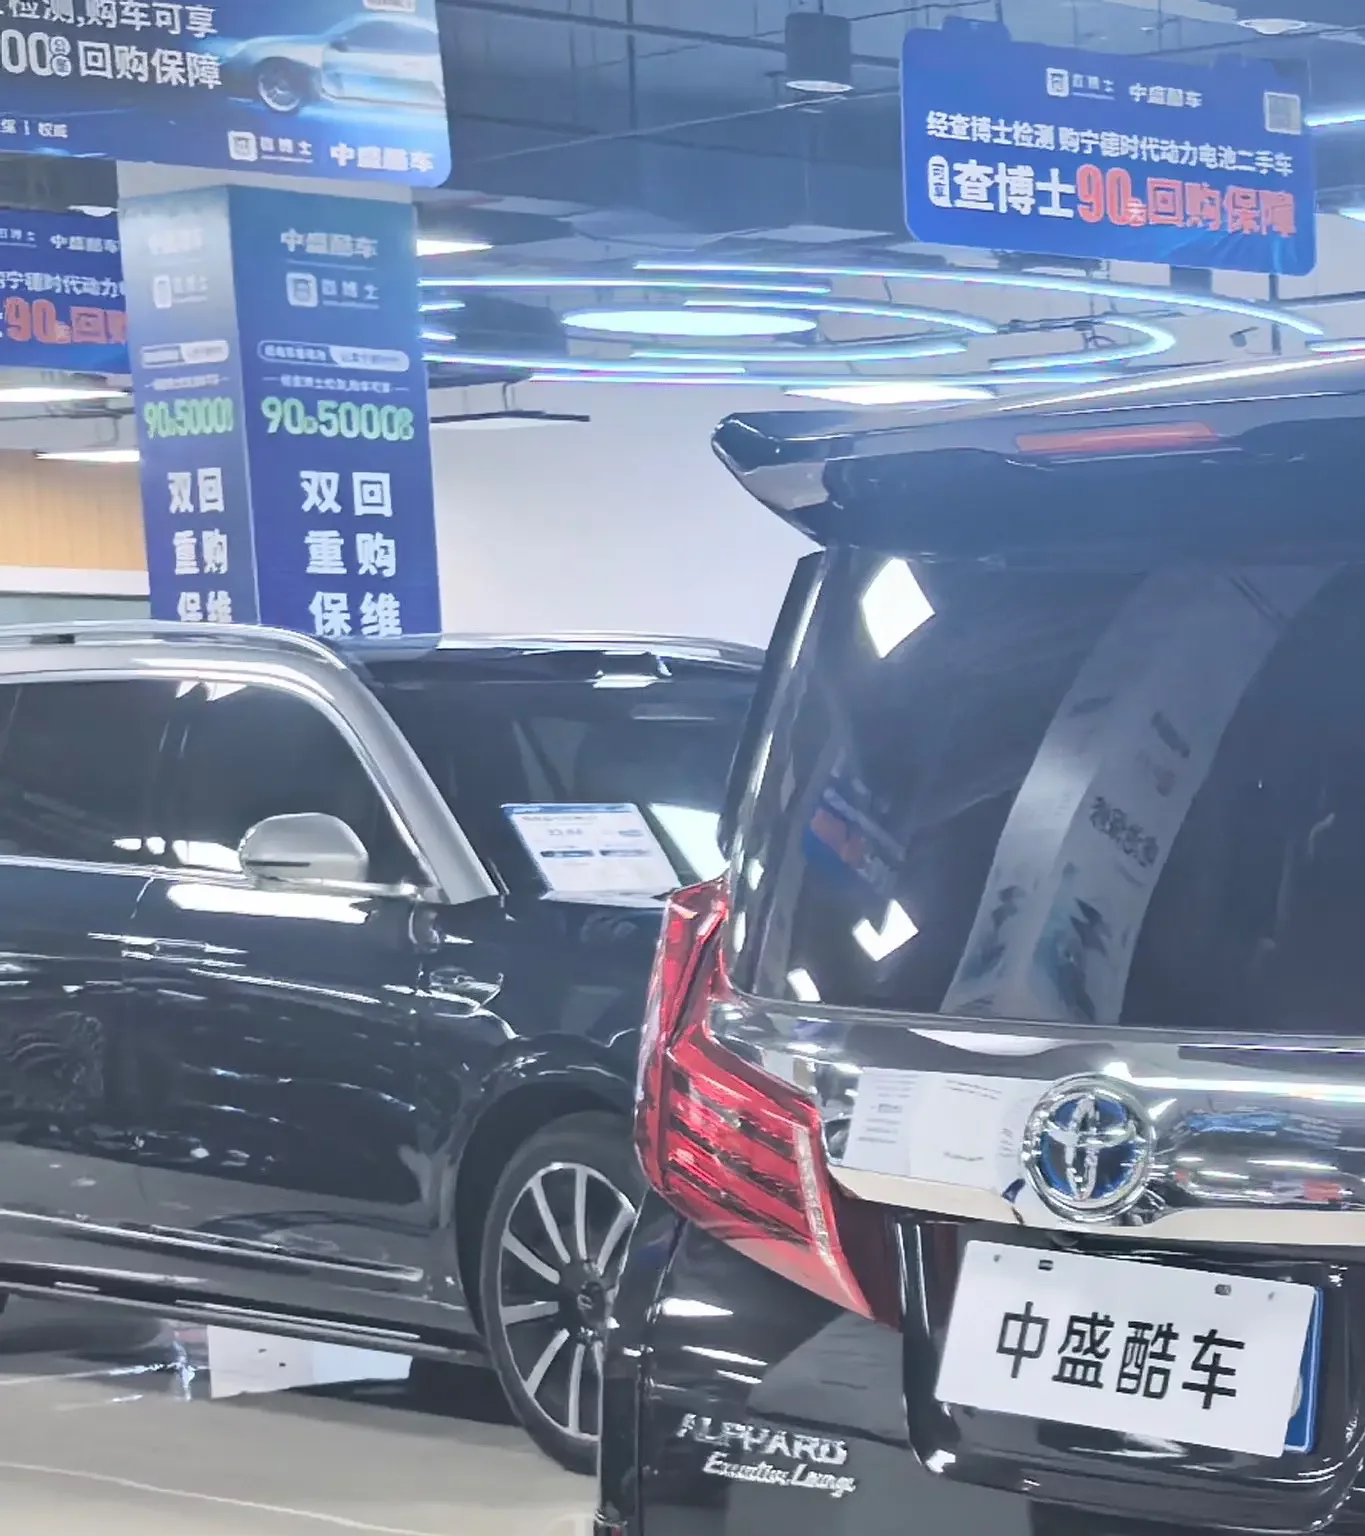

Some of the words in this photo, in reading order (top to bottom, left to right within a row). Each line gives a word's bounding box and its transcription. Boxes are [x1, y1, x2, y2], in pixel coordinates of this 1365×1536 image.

[0, 0, 218, 38] 检测,购车可享
[926, 110, 1055, 152] 经查博士检测
[1059, 126, 1294, 177] 购宁德时代动力电池二手车
[994, 1300, 1246, 1411] 中盛酷车
